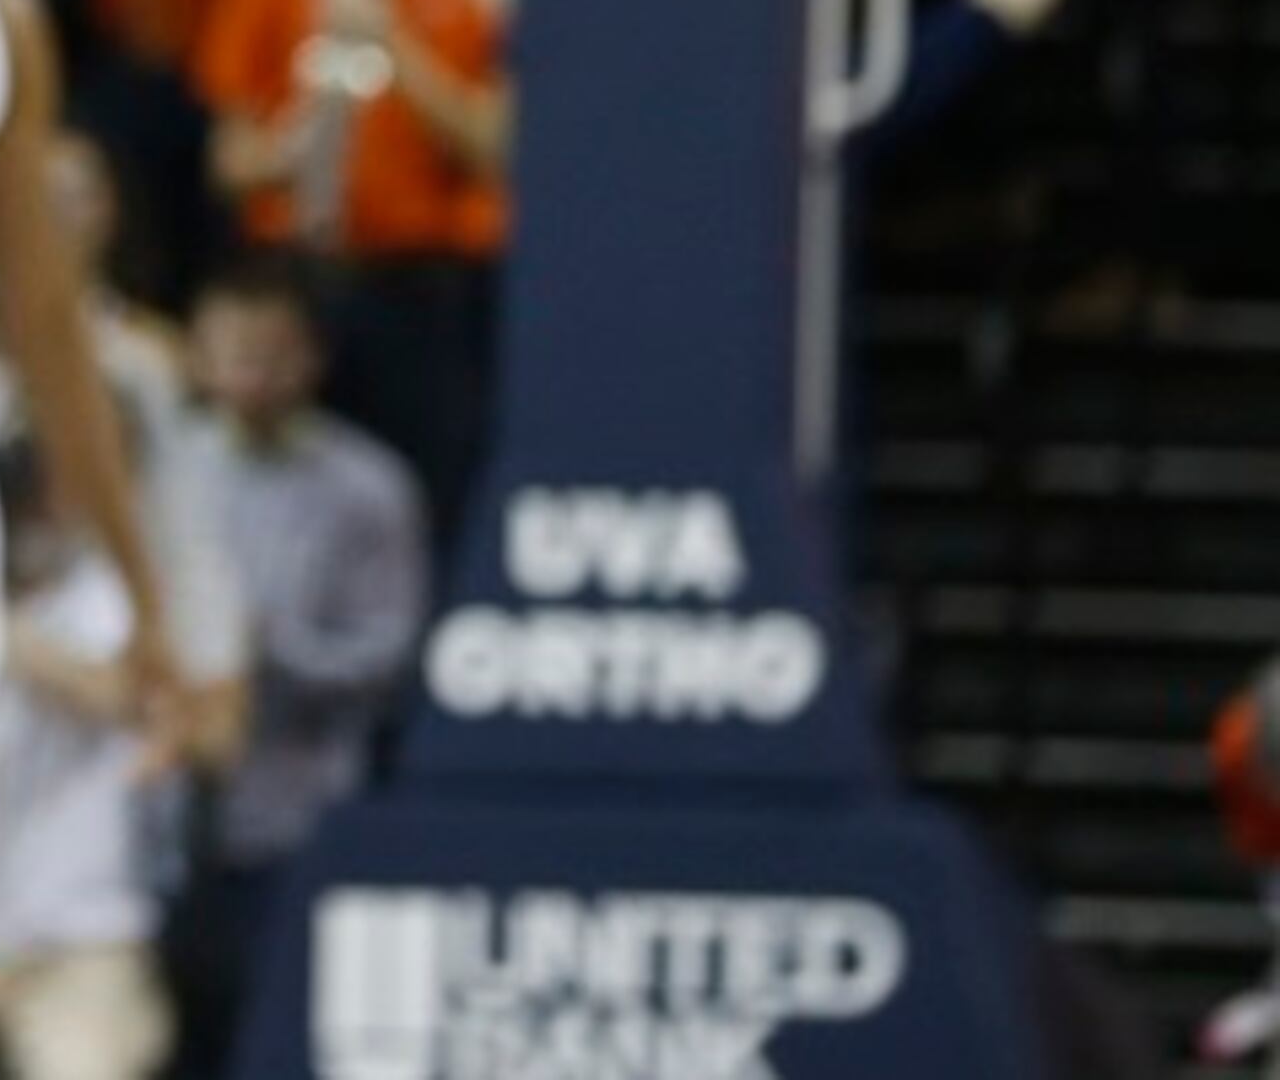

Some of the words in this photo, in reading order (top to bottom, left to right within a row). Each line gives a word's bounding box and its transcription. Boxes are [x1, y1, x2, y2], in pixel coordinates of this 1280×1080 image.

[503, 486, 745, 600] UVA
[424, 604, 826, 724] ORTHO
[440, 886, 905, 1018] UNITED
